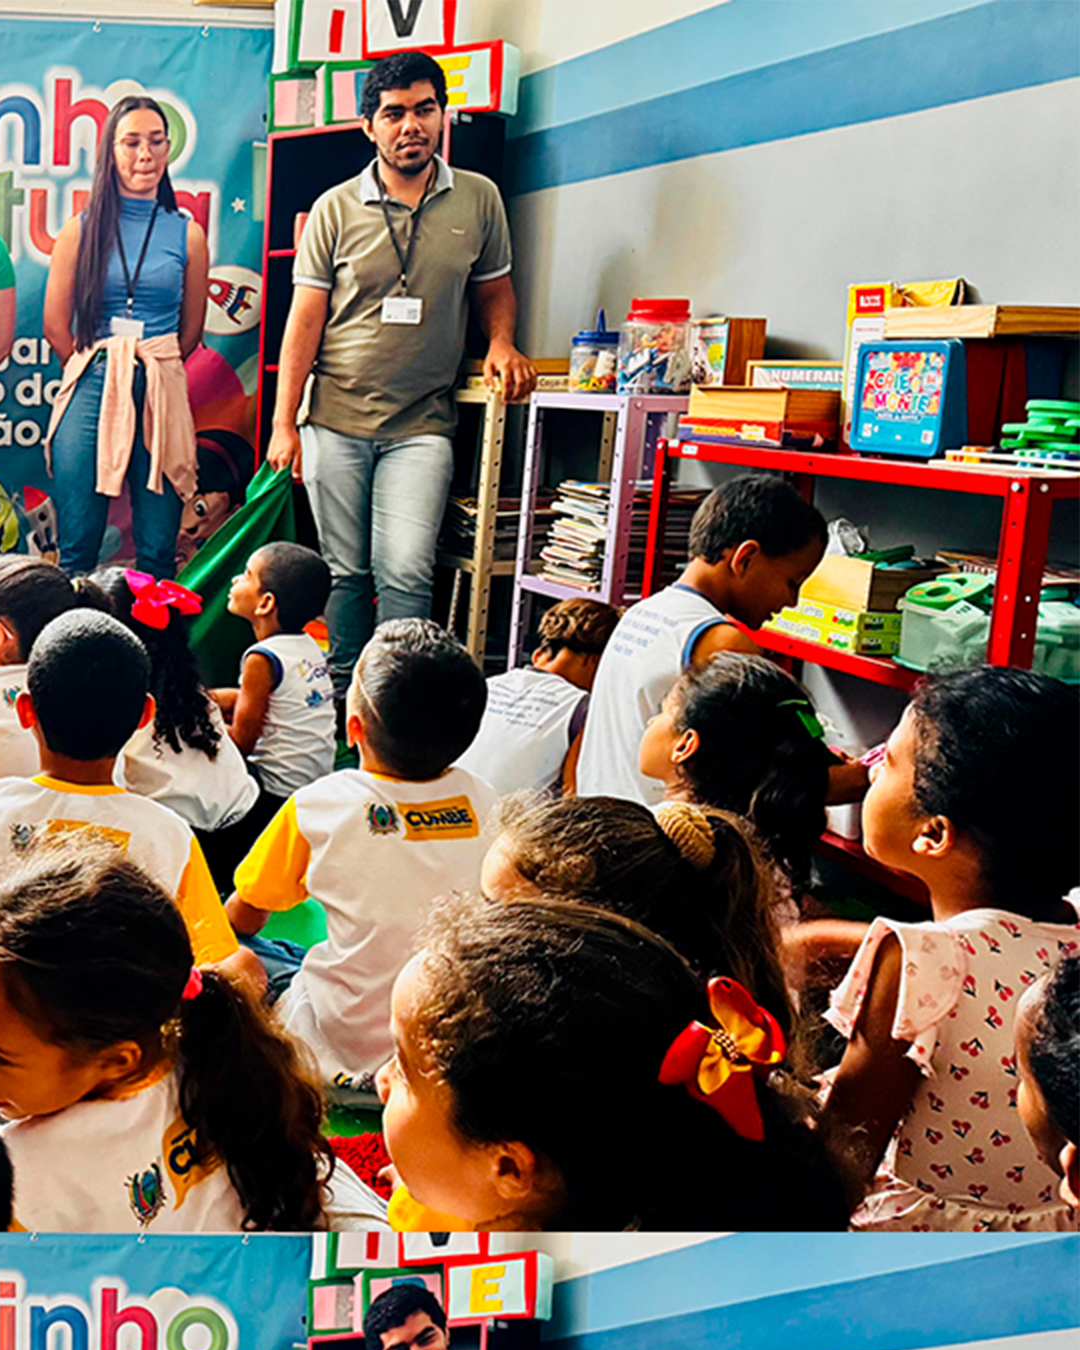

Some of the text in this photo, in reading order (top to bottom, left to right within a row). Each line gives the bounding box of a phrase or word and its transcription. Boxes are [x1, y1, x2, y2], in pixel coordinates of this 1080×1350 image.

[386, 0, 423, 38] V
[873, 392, 930, 413] MONTE
[405, 808, 473, 827] CUMBE
[469, 1264, 507, 1314] E
